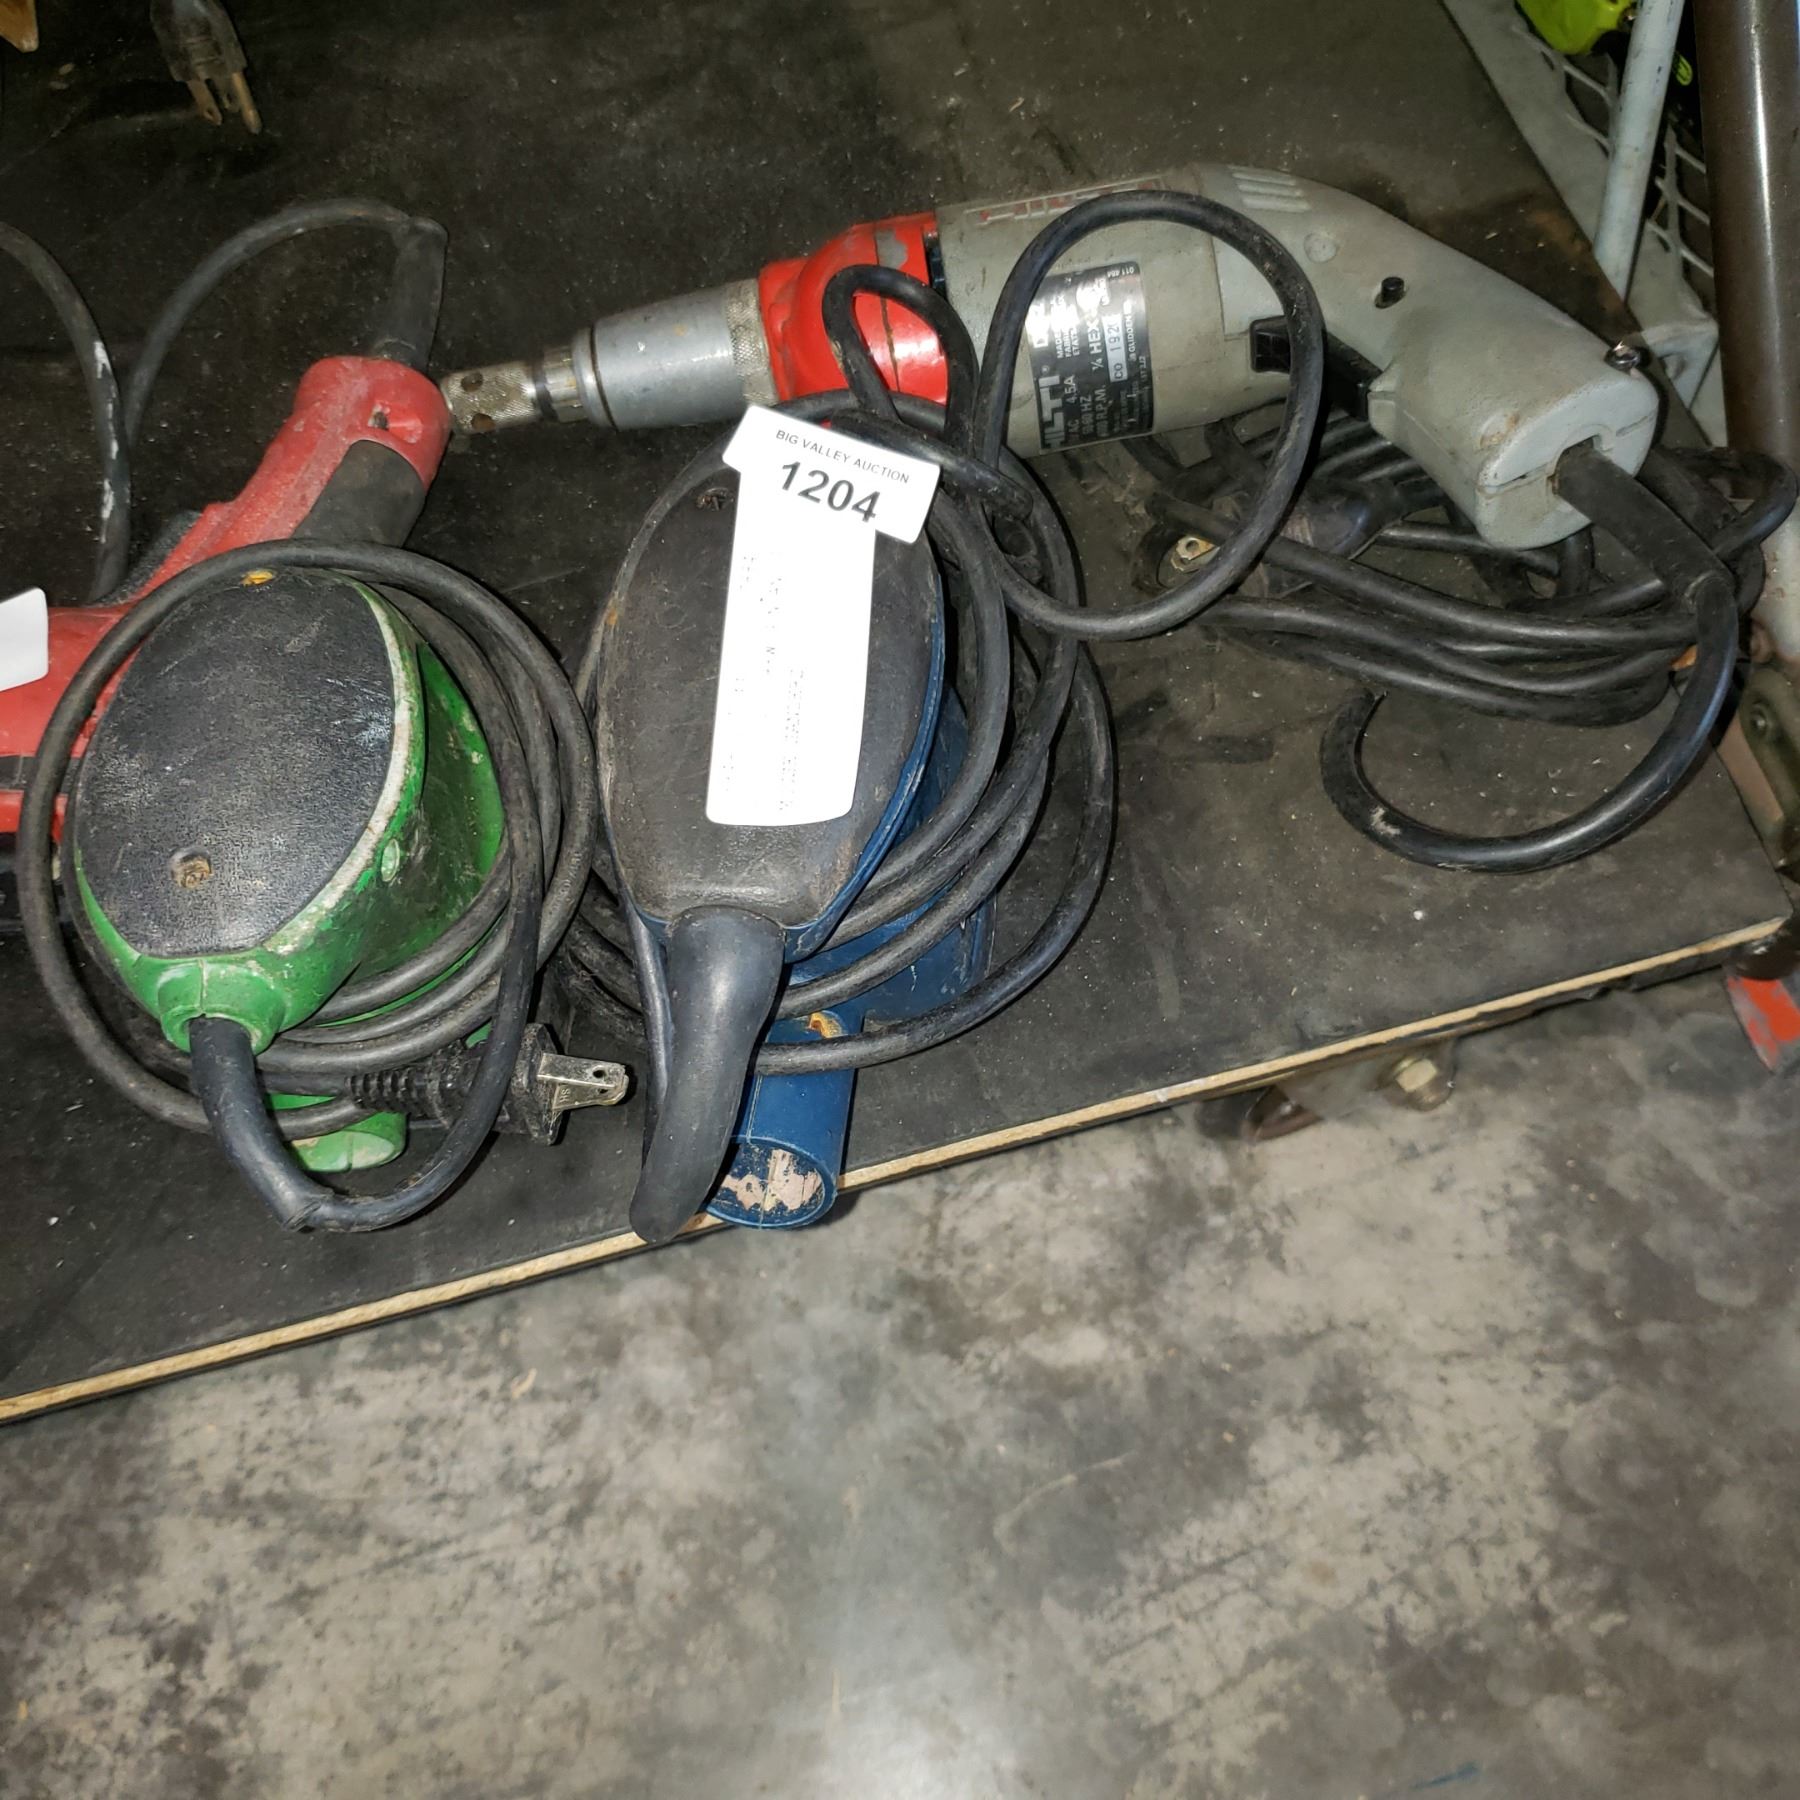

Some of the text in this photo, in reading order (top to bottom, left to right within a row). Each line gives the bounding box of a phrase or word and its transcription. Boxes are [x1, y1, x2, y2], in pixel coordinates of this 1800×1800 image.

[1086, 319, 1103, 355] HEX
[1039, 375, 1065, 449] HILTI
[776, 429, 910, 484] BIG VALLEY AUCTION
[782, 461, 881, 523] 1204
